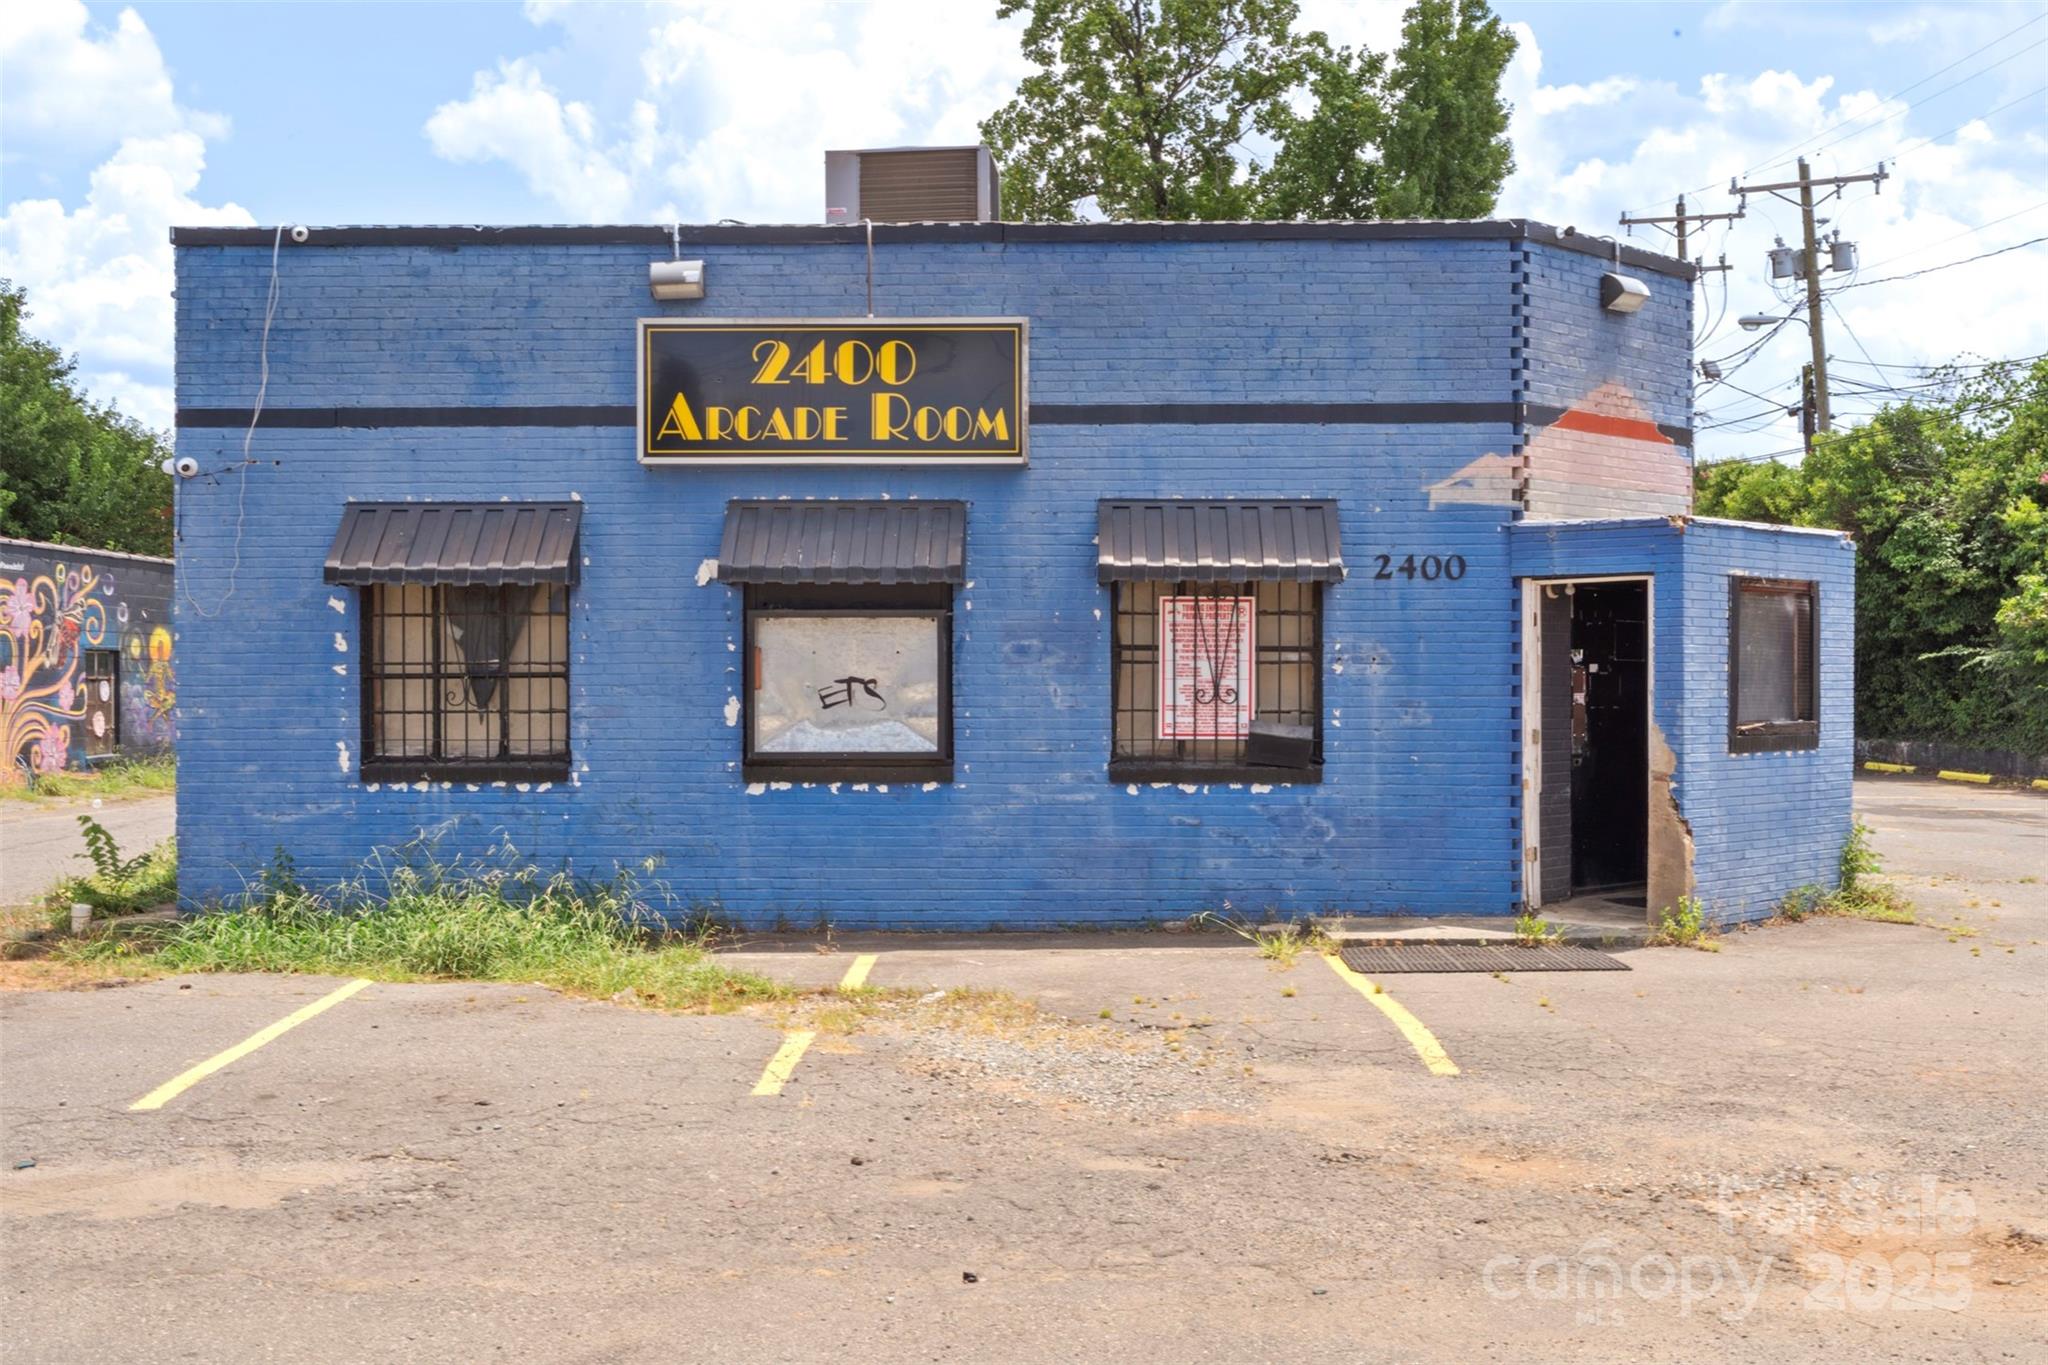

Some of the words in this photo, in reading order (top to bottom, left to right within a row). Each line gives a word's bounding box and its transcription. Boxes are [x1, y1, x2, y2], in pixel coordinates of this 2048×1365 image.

[750, 339, 917, 385] 2400
[656, 391, 849, 441] ARCADE
[871, 392, 1010, 442] ROOM
[1374, 554, 1466, 581] 2400
